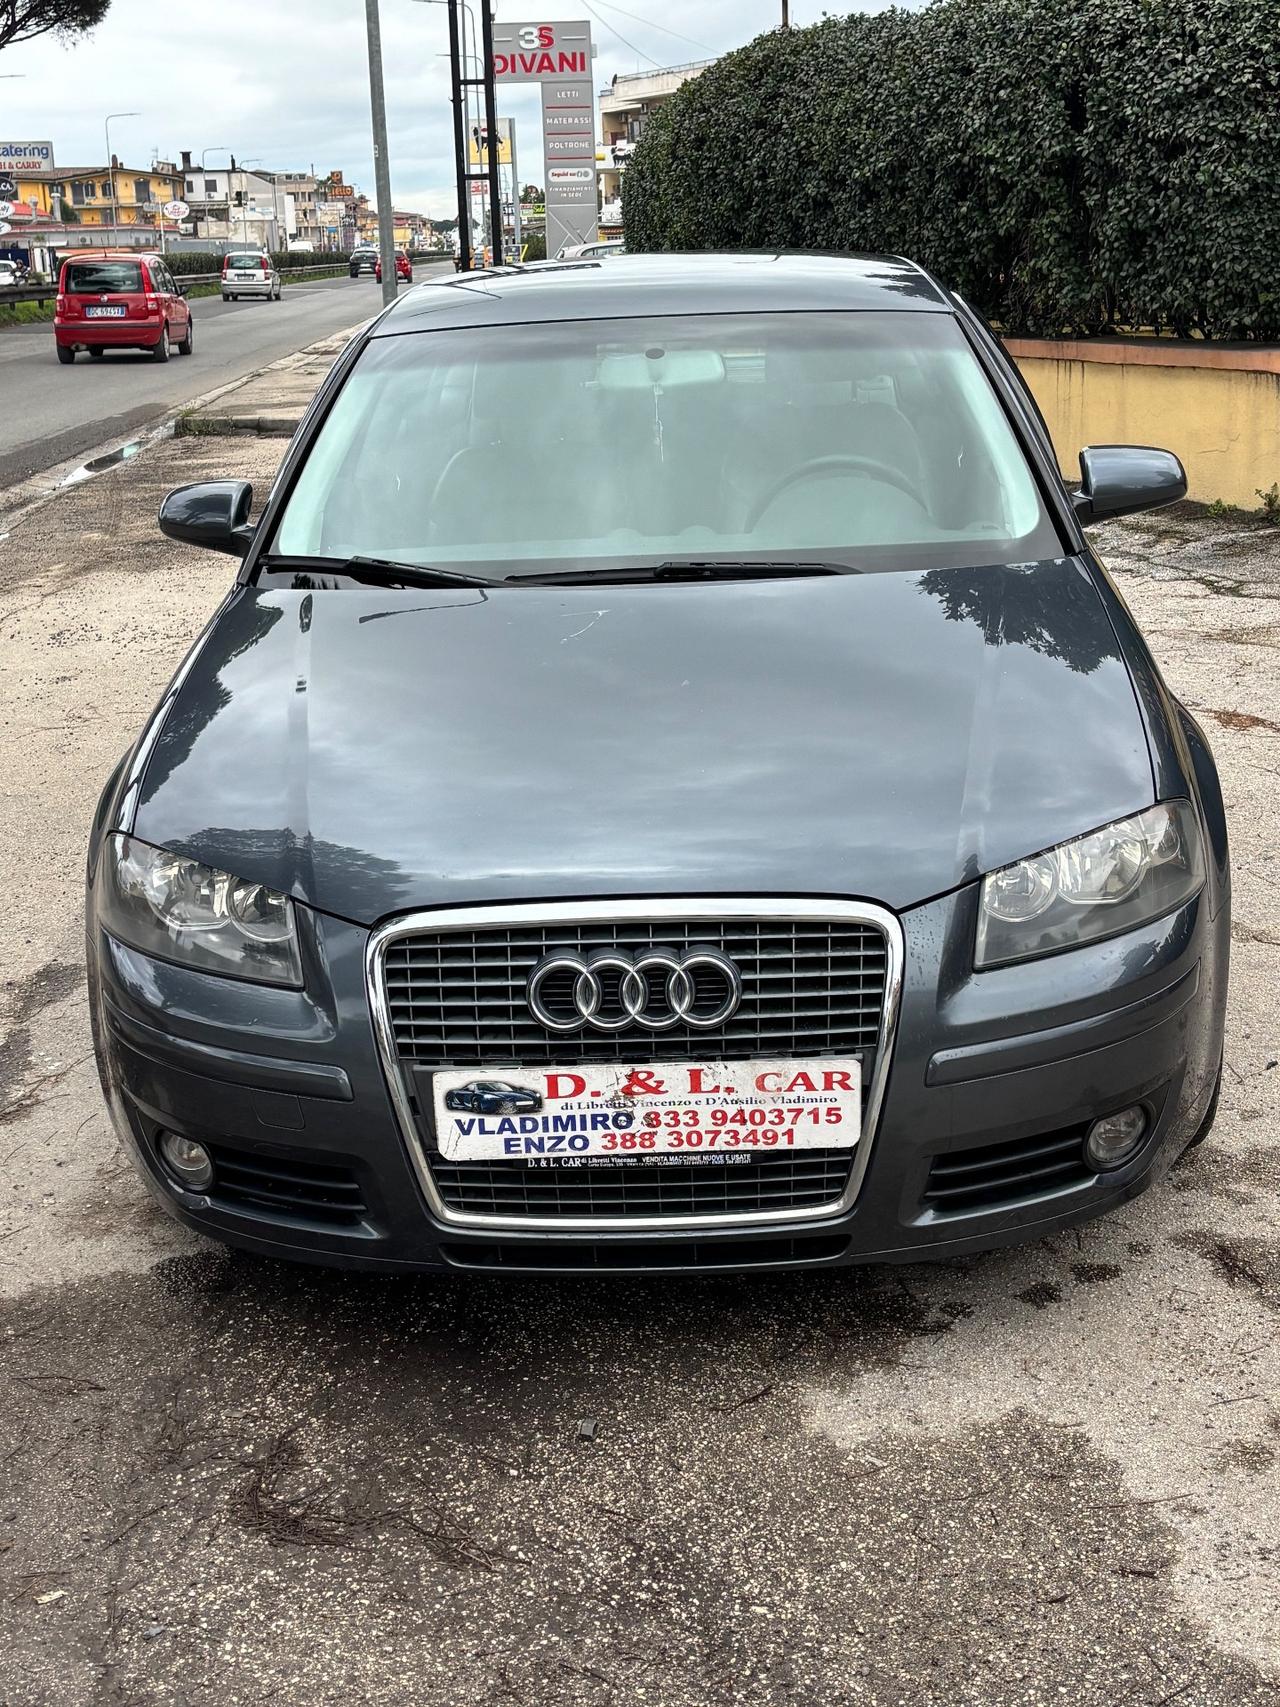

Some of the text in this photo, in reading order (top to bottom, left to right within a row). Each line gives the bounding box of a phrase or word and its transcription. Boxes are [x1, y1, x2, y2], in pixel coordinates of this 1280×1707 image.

[518, 24, 556, 50] 3S
[494, 52, 586, 75] DIVANI
[557, 90, 579, 98] LETTI
[546, 117, 592, 125] MATERASSI
[549, 141, 590, 149] POLTRONE
[15, 161, 42, 170] CARRY
[544, 1068, 856, 1099] D. & L. CAR
[561, 1102, 573, 1111] di
[629, 1098, 692, 1109] Vincenzo
[771, 1096, 838, 1105] Vladimiro
[455, 1111, 633, 1136] VLADIMIRO
[711, 1107, 843, 1127] 9403715
[504, 1128, 795, 1155] ENZO 388 3073491
[527, 1158, 538, 1167] D.
[540, 1158, 547, 1167] &
[550, 1158, 559, 1167] L.
[561, 1158, 582, 1167] CAR
[642, 1155, 669, 1163] VENDITA
[731, 1153, 752, 1161] USATE
